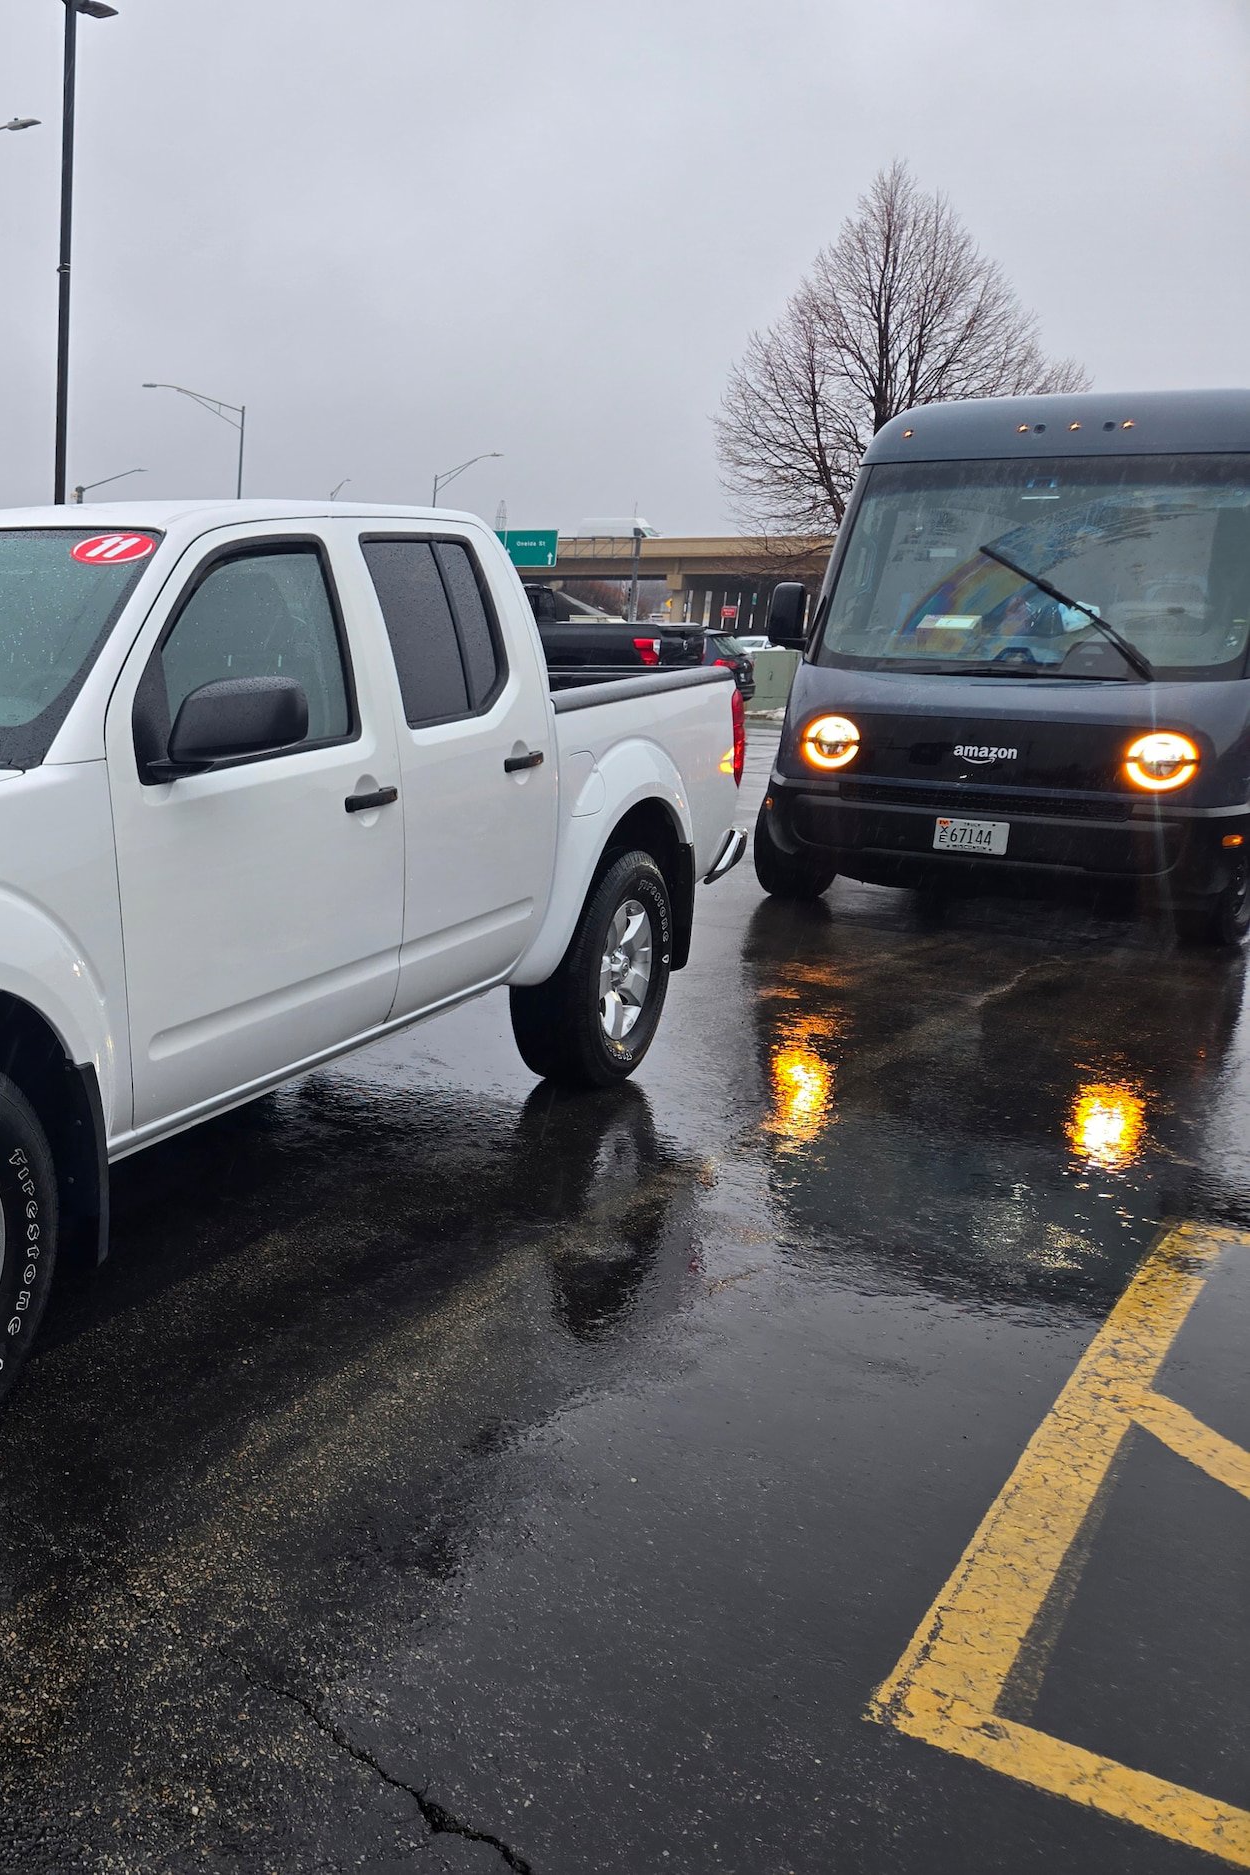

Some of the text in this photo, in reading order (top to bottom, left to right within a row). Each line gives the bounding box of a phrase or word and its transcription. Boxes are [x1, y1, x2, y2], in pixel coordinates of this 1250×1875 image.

[85, 536, 142, 558] 11
[953, 745, 1018, 764] amazon
[950, 828, 992, 846] 67144
[8, 1147, 40, 1336] Firestone
